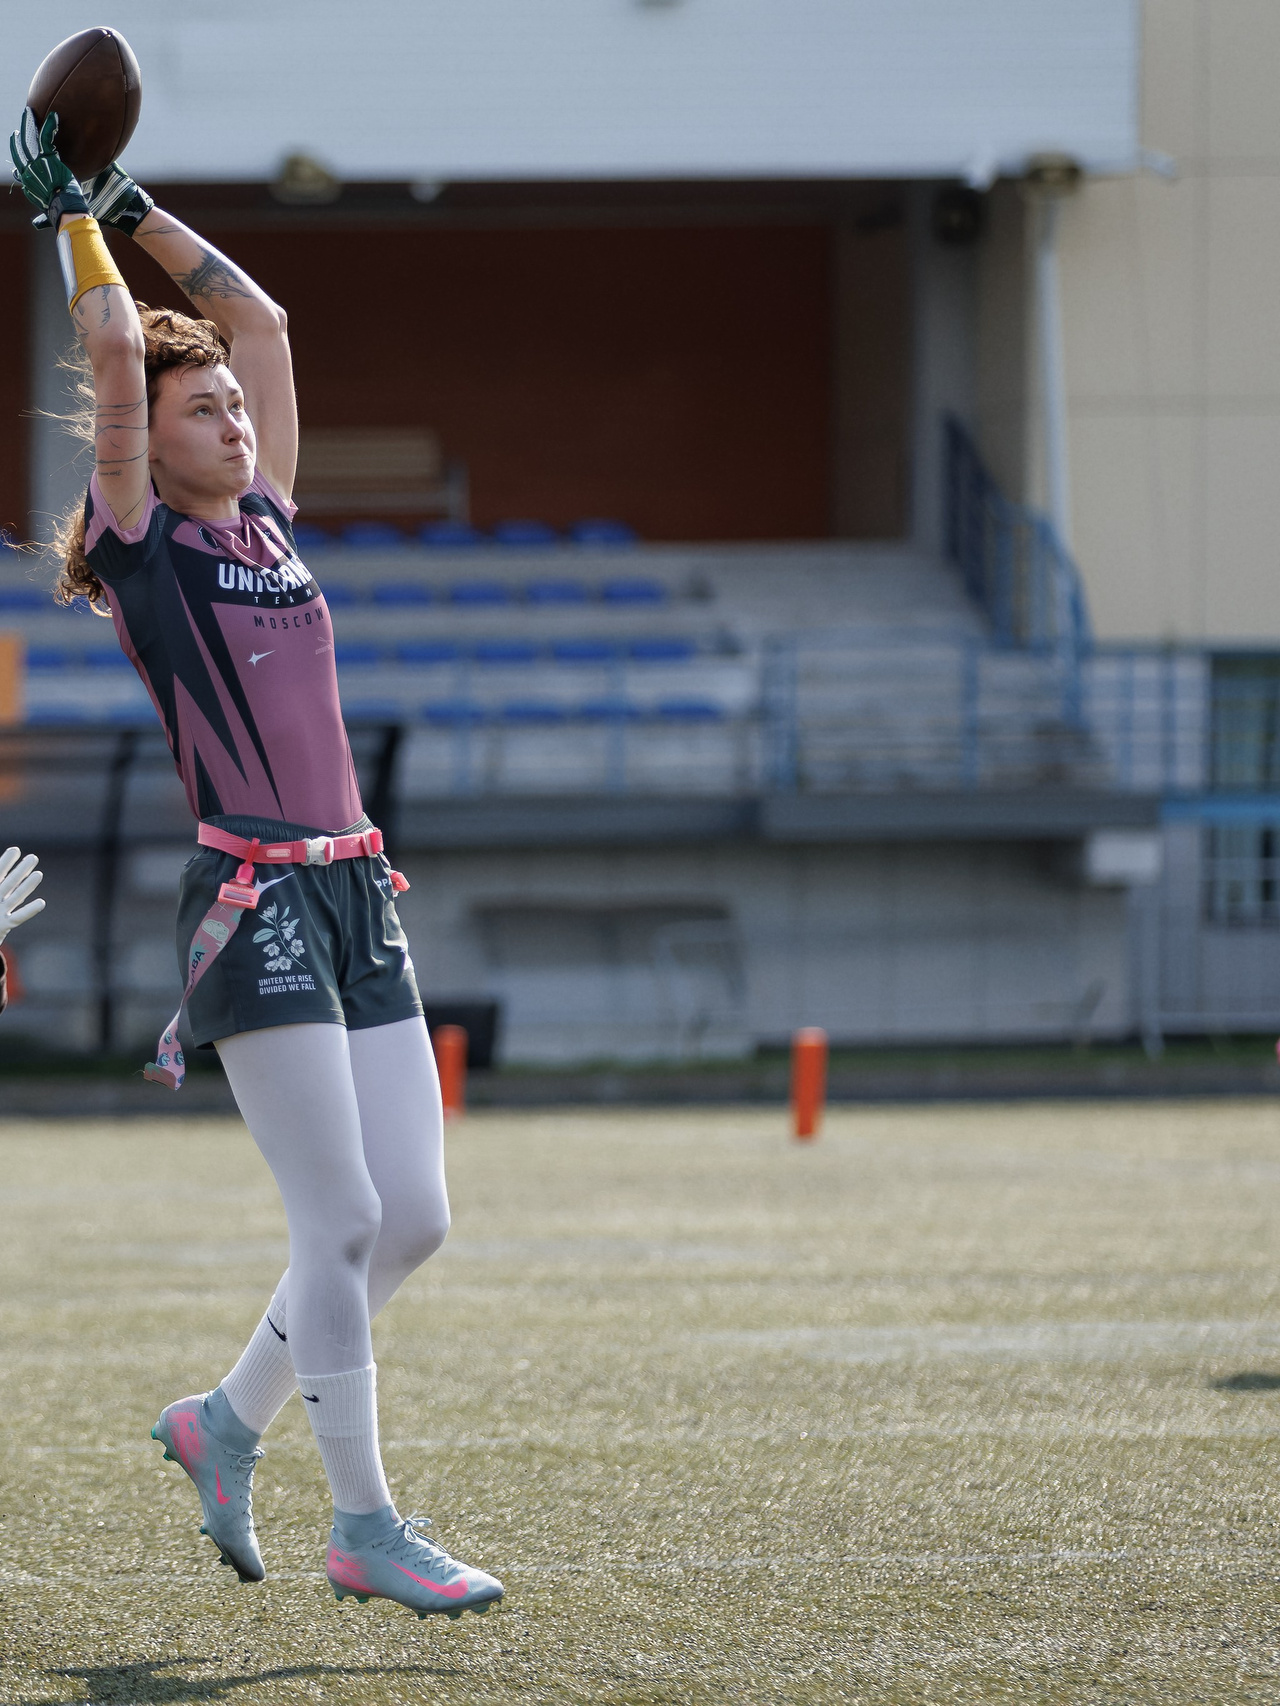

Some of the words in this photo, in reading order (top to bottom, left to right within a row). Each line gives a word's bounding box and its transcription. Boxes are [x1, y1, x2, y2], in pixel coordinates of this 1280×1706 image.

[254, 588, 313, 605] TEAM
[253, 607, 324, 629] MOSCOW
[258, 976, 284, 987] UNITED
[285, 975, 297, 983] WE
[298, 974, 315, 982] RISE,
[259, 984, 287, 995] DIVIDED
[288, 983, 300, 992] WE
[301, 982, 317, 991] FALL
